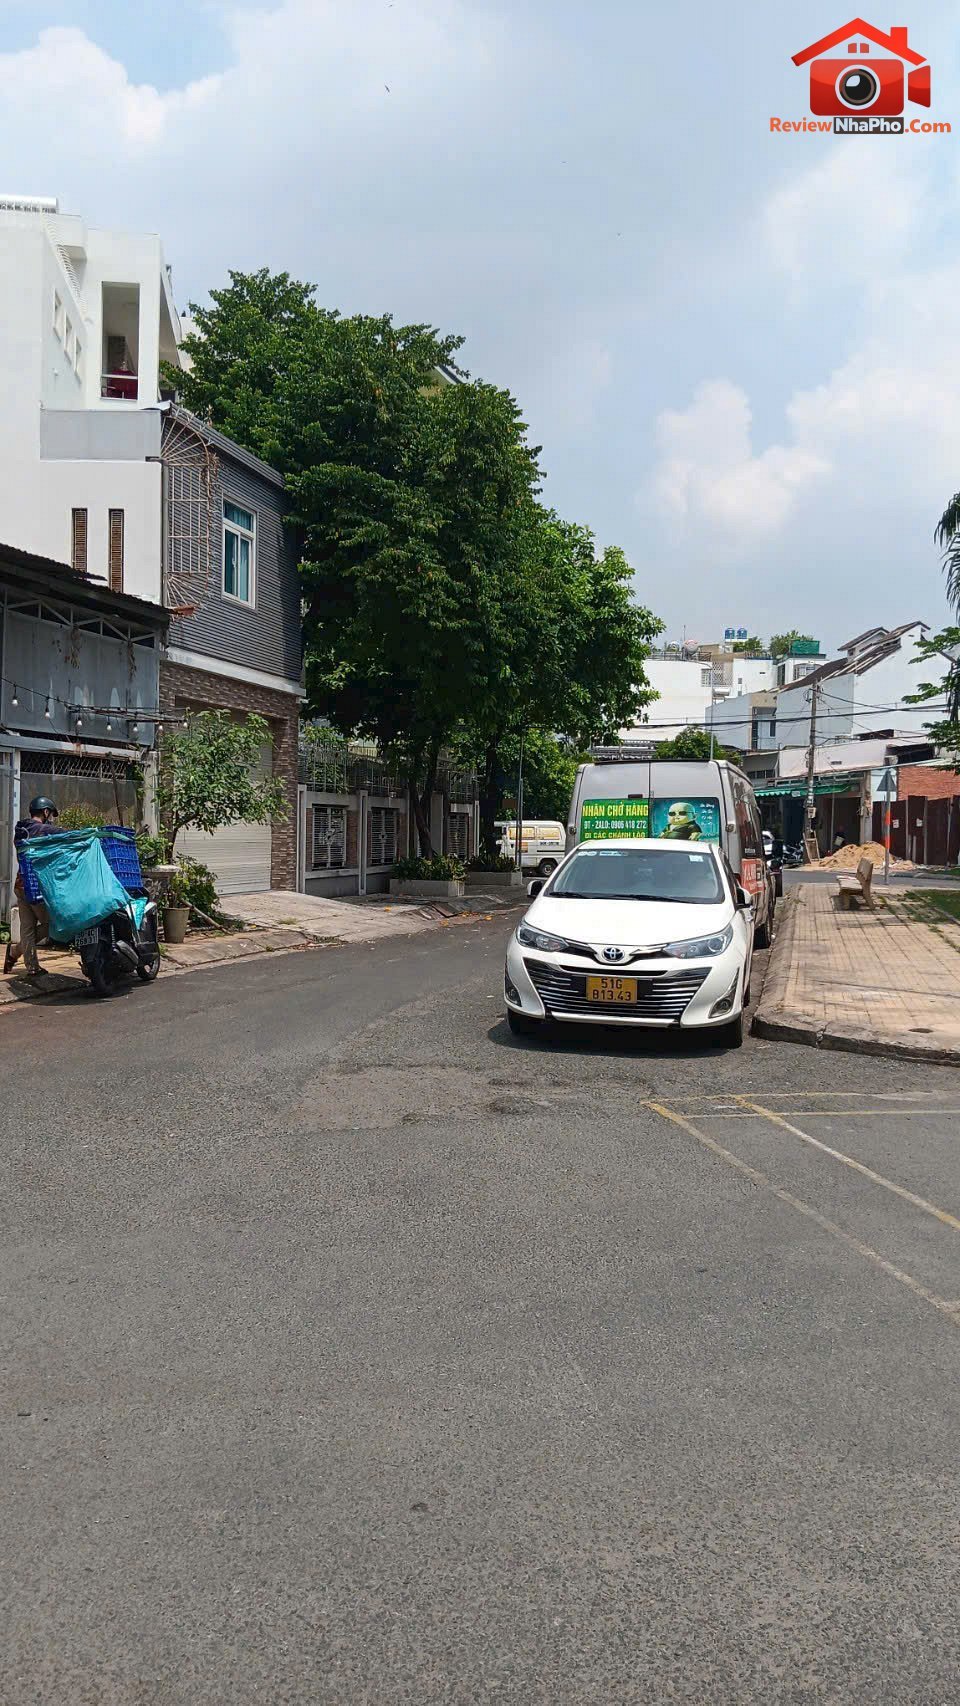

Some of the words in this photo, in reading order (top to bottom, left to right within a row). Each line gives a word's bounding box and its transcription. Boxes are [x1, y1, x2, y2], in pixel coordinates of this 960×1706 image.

[582, 803, 605, 819] NHẬN
[607, 801, 625, 817] CHỞ
[626, 802, 649, 817] HÀNG
[636, 820, 648, 829] 272
[601, 978, 623, 989] 51G
[592, 989, 631, 1001] 813.43
